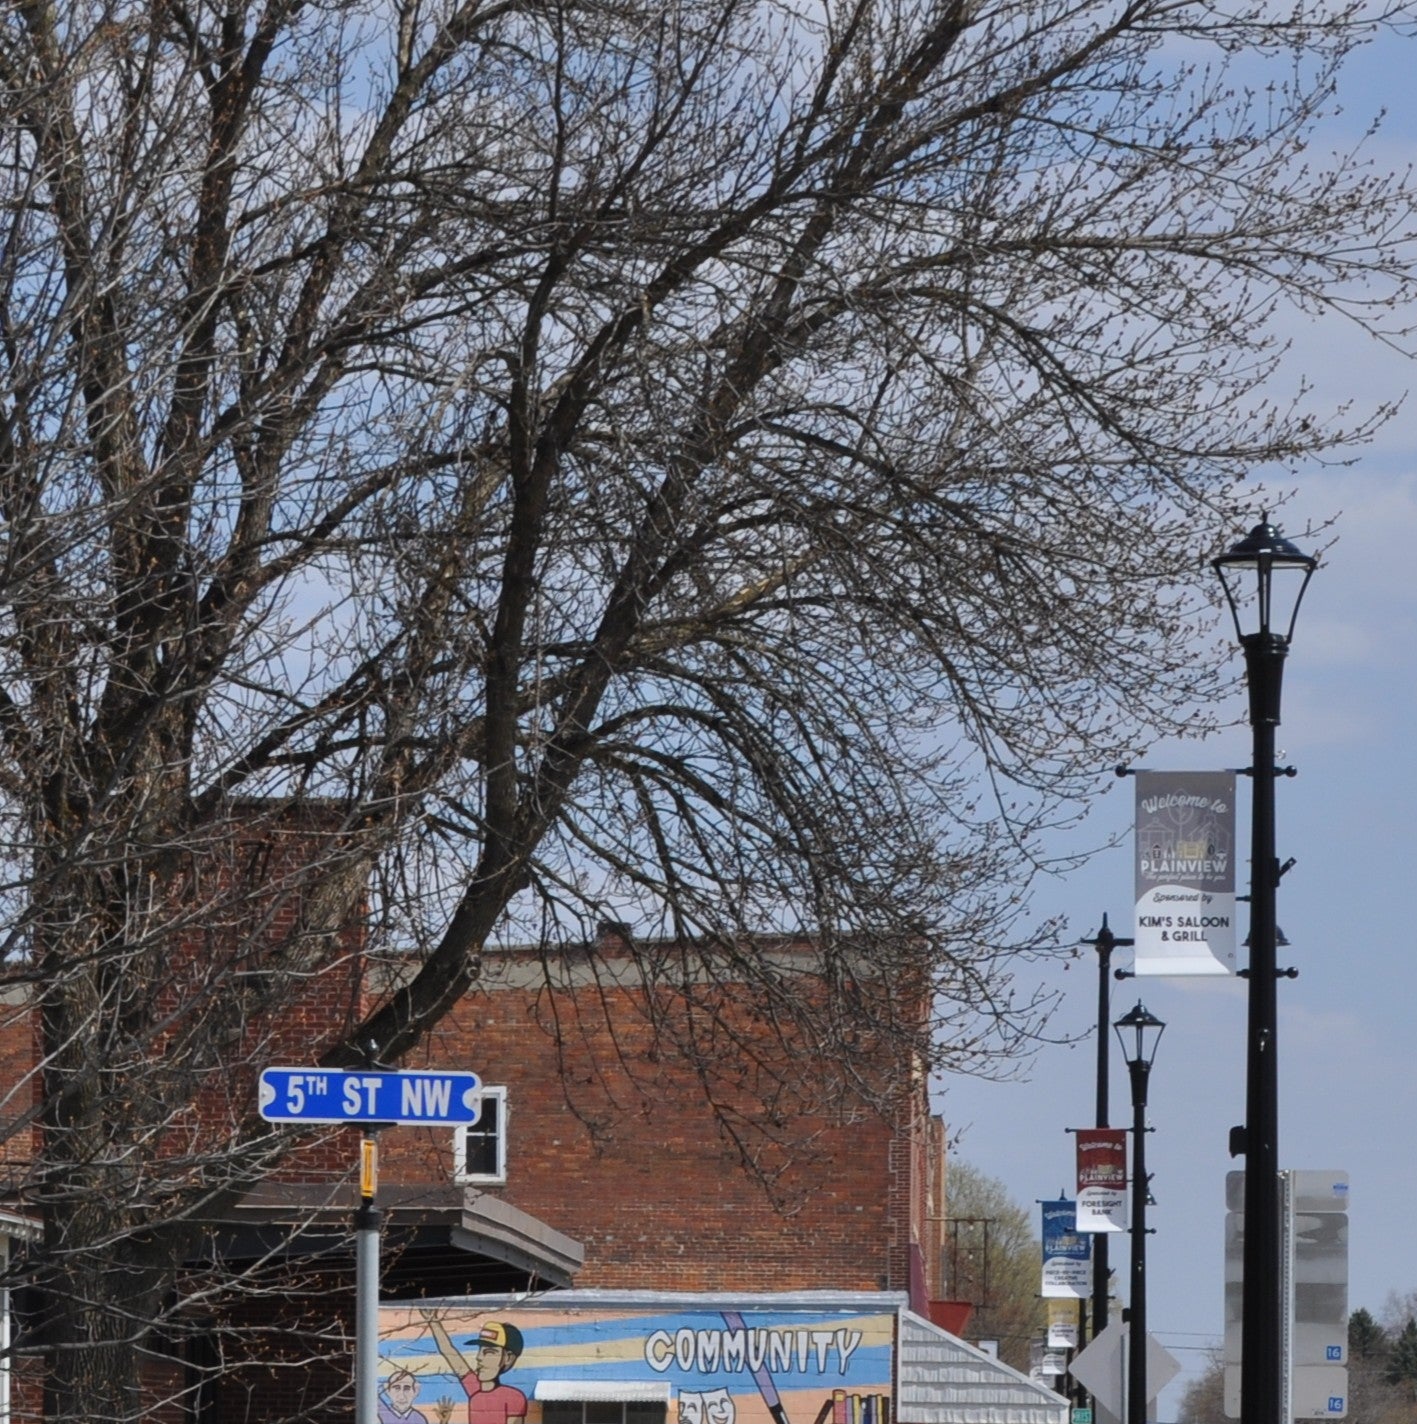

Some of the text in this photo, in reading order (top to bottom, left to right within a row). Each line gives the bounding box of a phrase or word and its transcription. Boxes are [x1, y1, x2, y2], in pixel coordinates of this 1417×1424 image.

[1141, 794, 1229, 814] Welcome to
[1140, 860, 1228, 873] PLAINVIEW
[1153, 893, 1214, 905] Sponsored by
[1138, 916, 1230, 928] KIM'S SALOON
[1161, 931, 1208, 942] & GRILL
[286, 1075, 452, 1118] 5TH ST NW
[1079, 1173, 1124, 1182] PLAINVIEW
[1082, 1200, 1123, 1208] FORESIGHT
[645, 1327, 863, 1376] COMMUNITY
[1328, 1347, 1341, 1358] 16
[1330, 1398, 1342, 1409] 16
